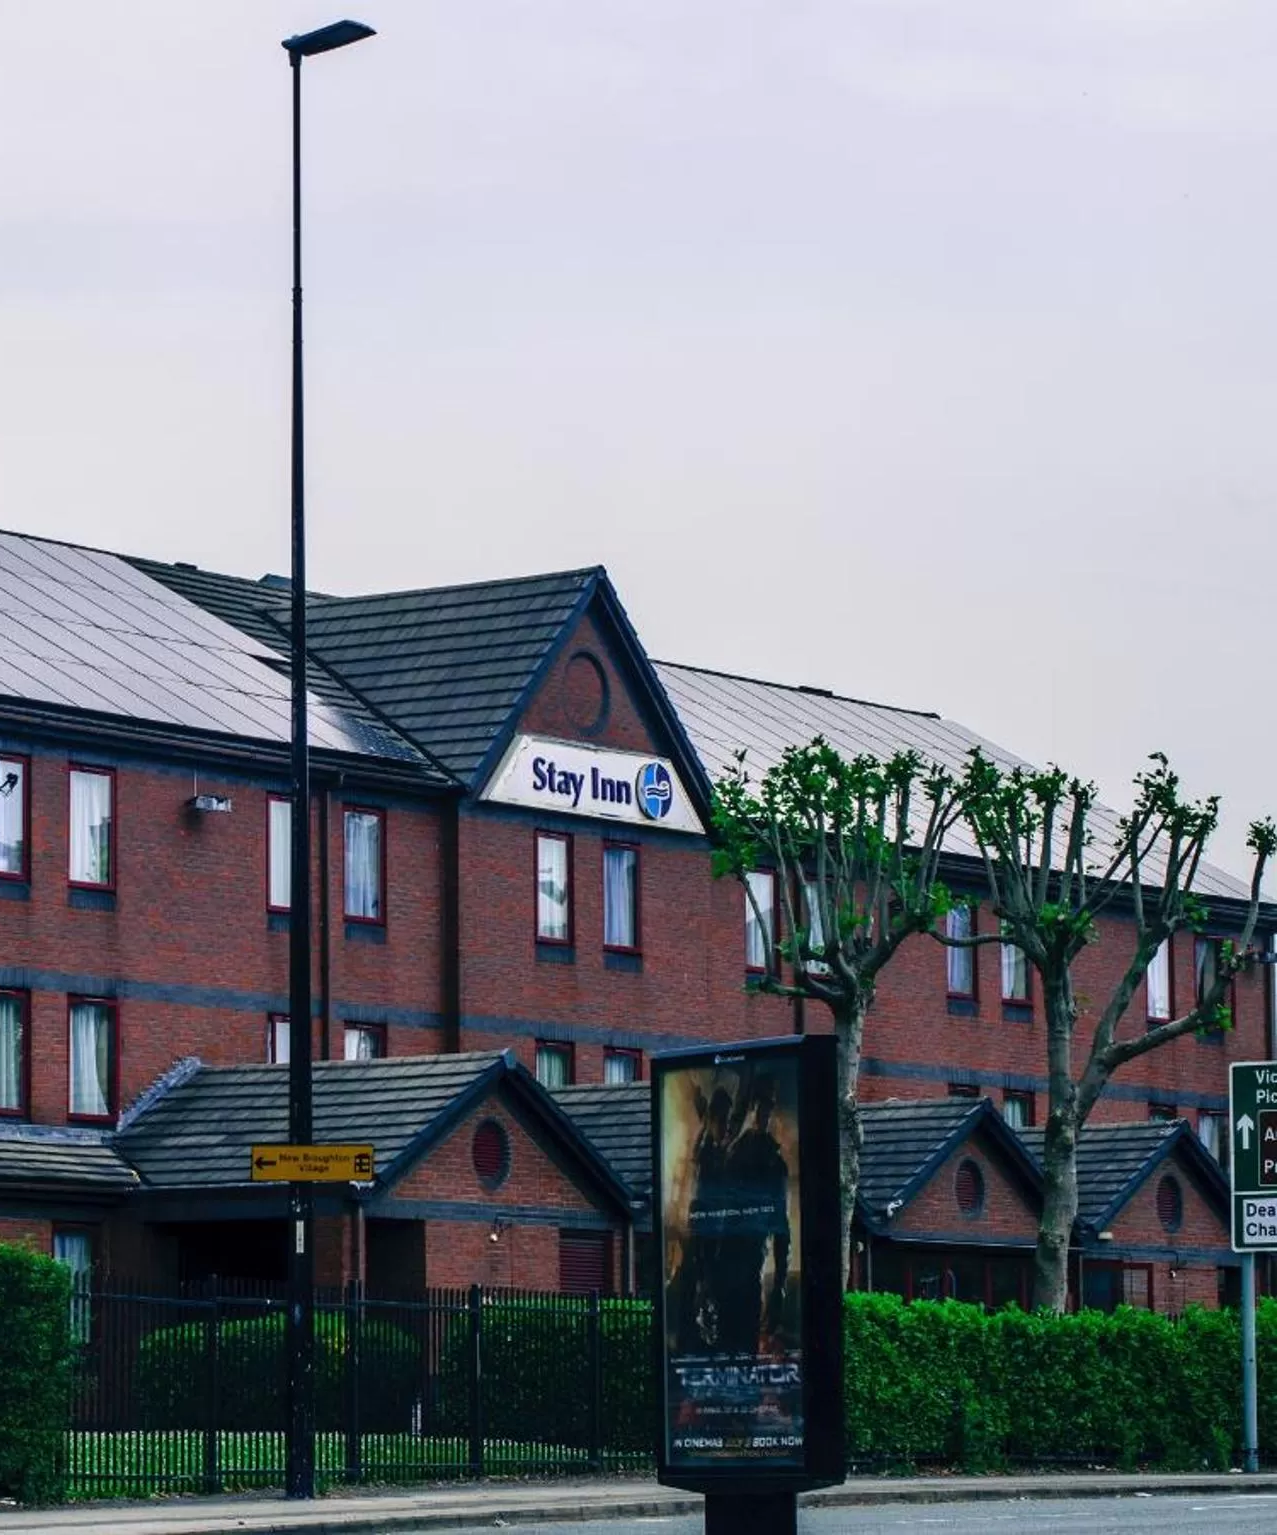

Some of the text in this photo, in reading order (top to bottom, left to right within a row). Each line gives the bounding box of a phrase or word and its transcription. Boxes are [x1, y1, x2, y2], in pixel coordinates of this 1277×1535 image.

[533, 757, 632, 807] Stay Inn
[279, 1153, 300, 1162] New
[675, 1363, 801, 1386] TERMINATOR
[684, 1437, 724, 1448] CINEMAS
[752, 1436, 779, 1448] BOOK
[781, 1435, 803, 1447] NOW
